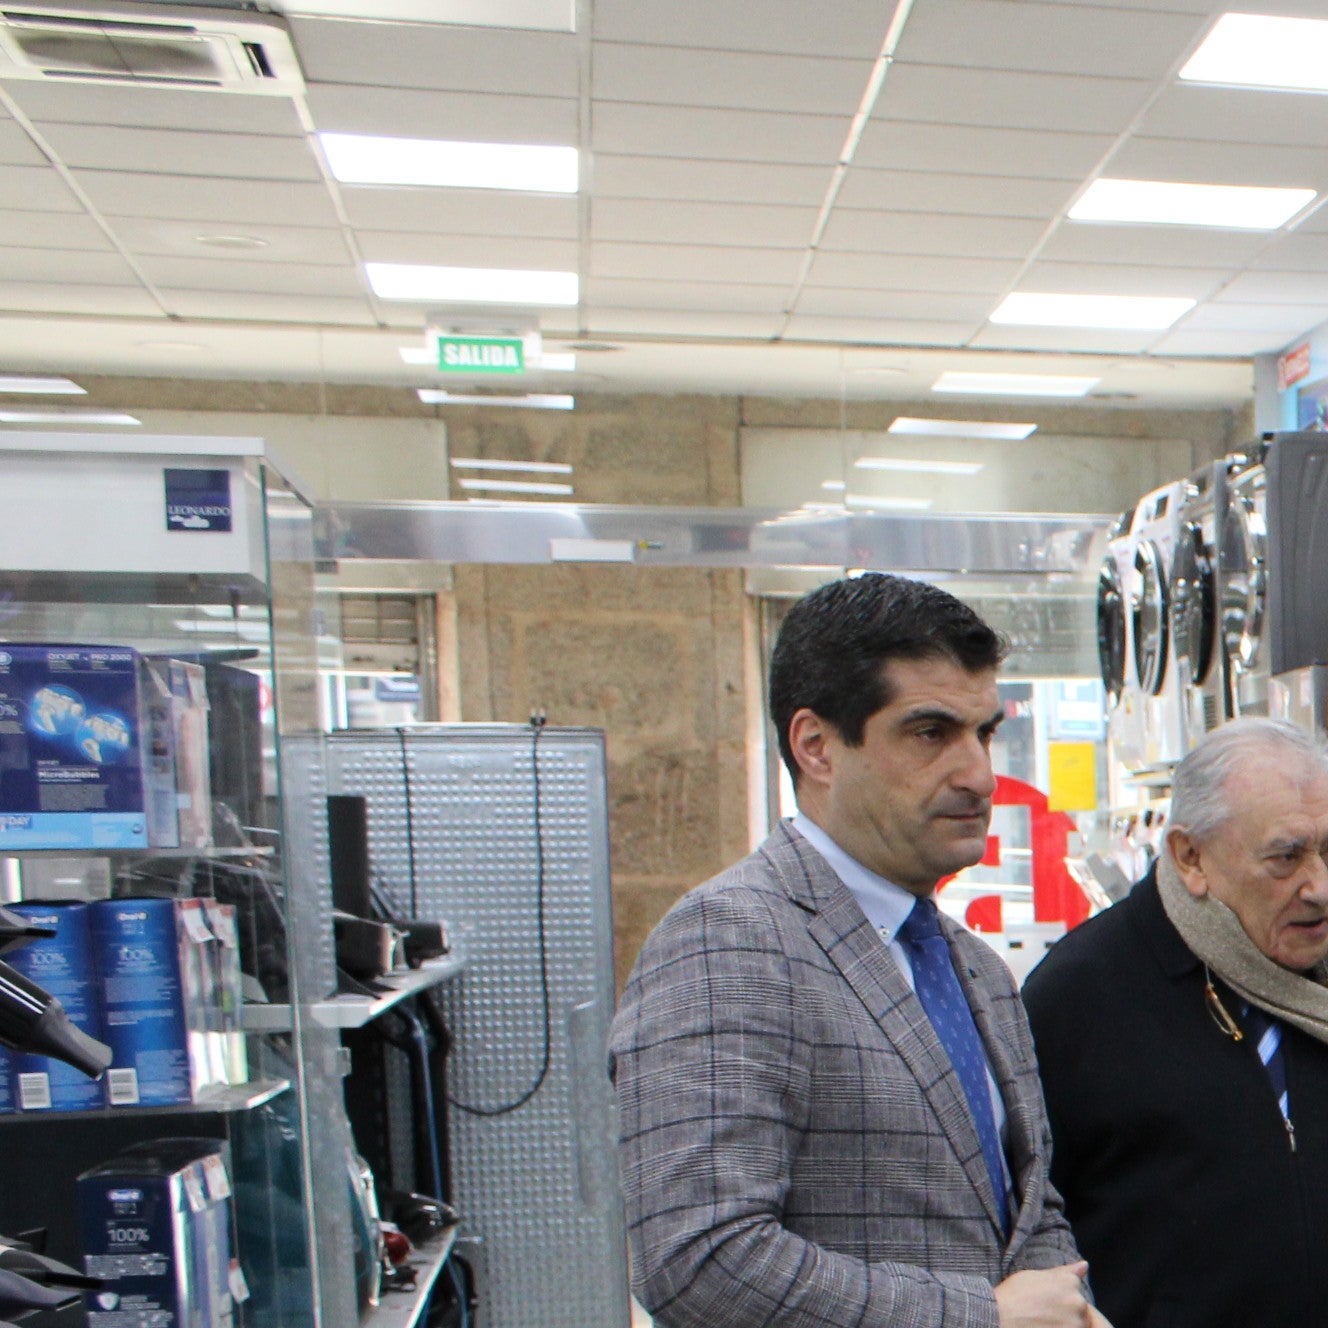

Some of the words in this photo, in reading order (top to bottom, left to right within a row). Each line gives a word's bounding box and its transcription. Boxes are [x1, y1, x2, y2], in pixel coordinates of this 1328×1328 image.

[443, 344, 519, 368] SALIDA
[168, 505, 230, 516] LEONARDO
[108, 1229, 149, 1241] 100%
